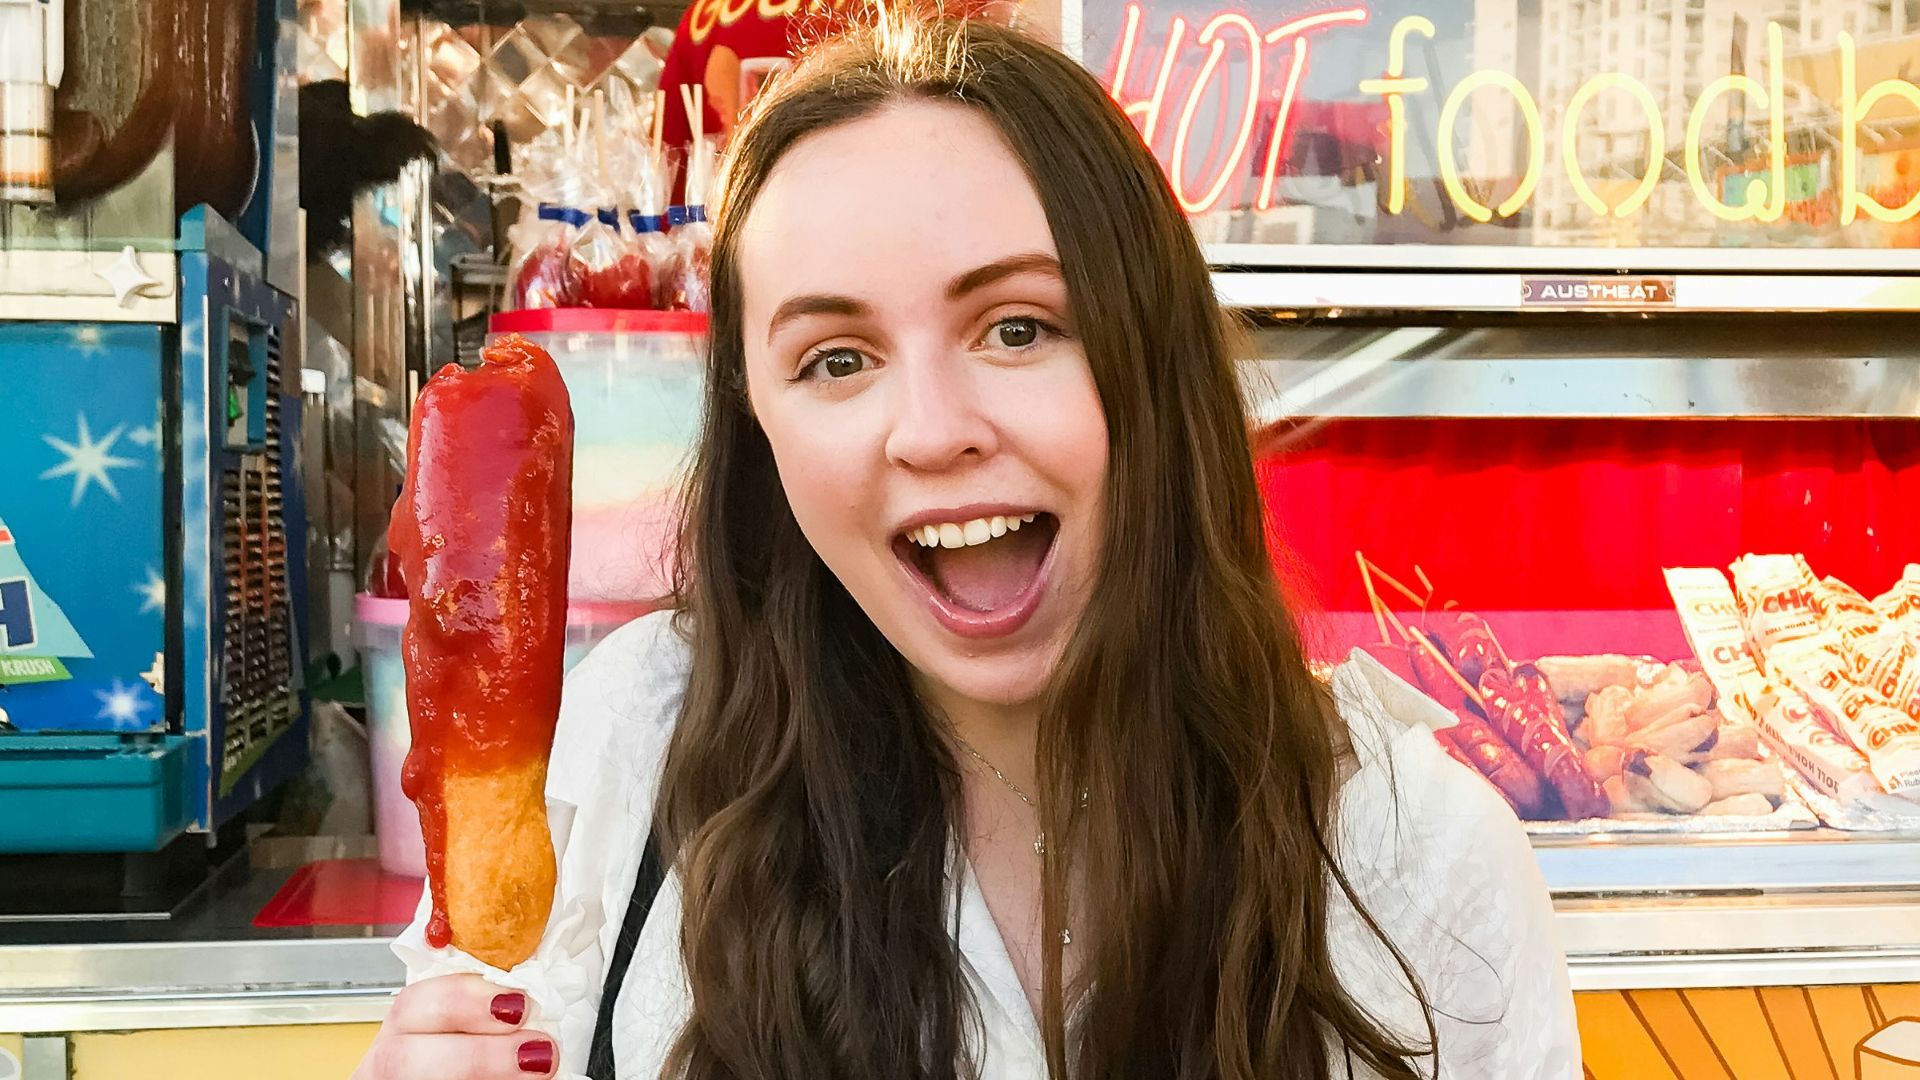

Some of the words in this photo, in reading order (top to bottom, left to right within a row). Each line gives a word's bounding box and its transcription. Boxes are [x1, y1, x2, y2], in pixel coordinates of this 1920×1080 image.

[1108, 2, 1369, 214] HOT
[1358, 15, 1786, 223] food
[1540, 284, 1658, 299] AUSTHEAT
[1, 658, 57, 677] KRUSH
